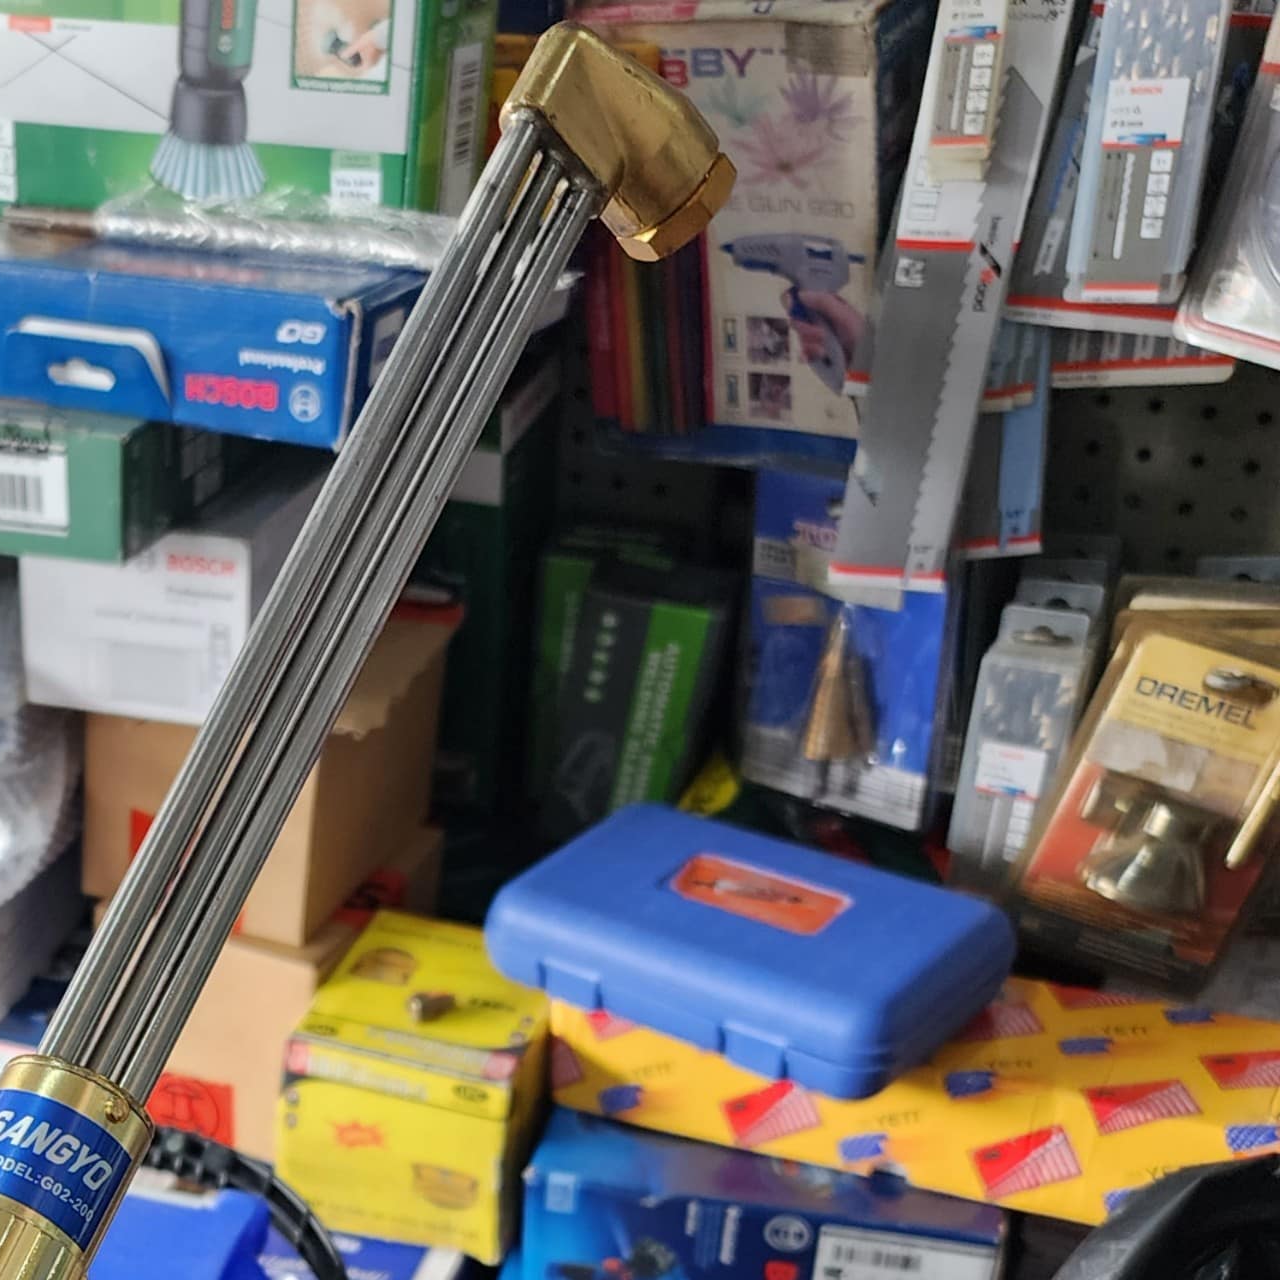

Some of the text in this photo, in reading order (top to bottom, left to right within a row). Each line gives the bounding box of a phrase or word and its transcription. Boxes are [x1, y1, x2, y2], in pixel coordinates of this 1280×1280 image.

[184, 373, 279, 413] BOSCH
[166, 552, 237, 577] BOSCH
[1135, 676, 1257, 731] DREMEL
